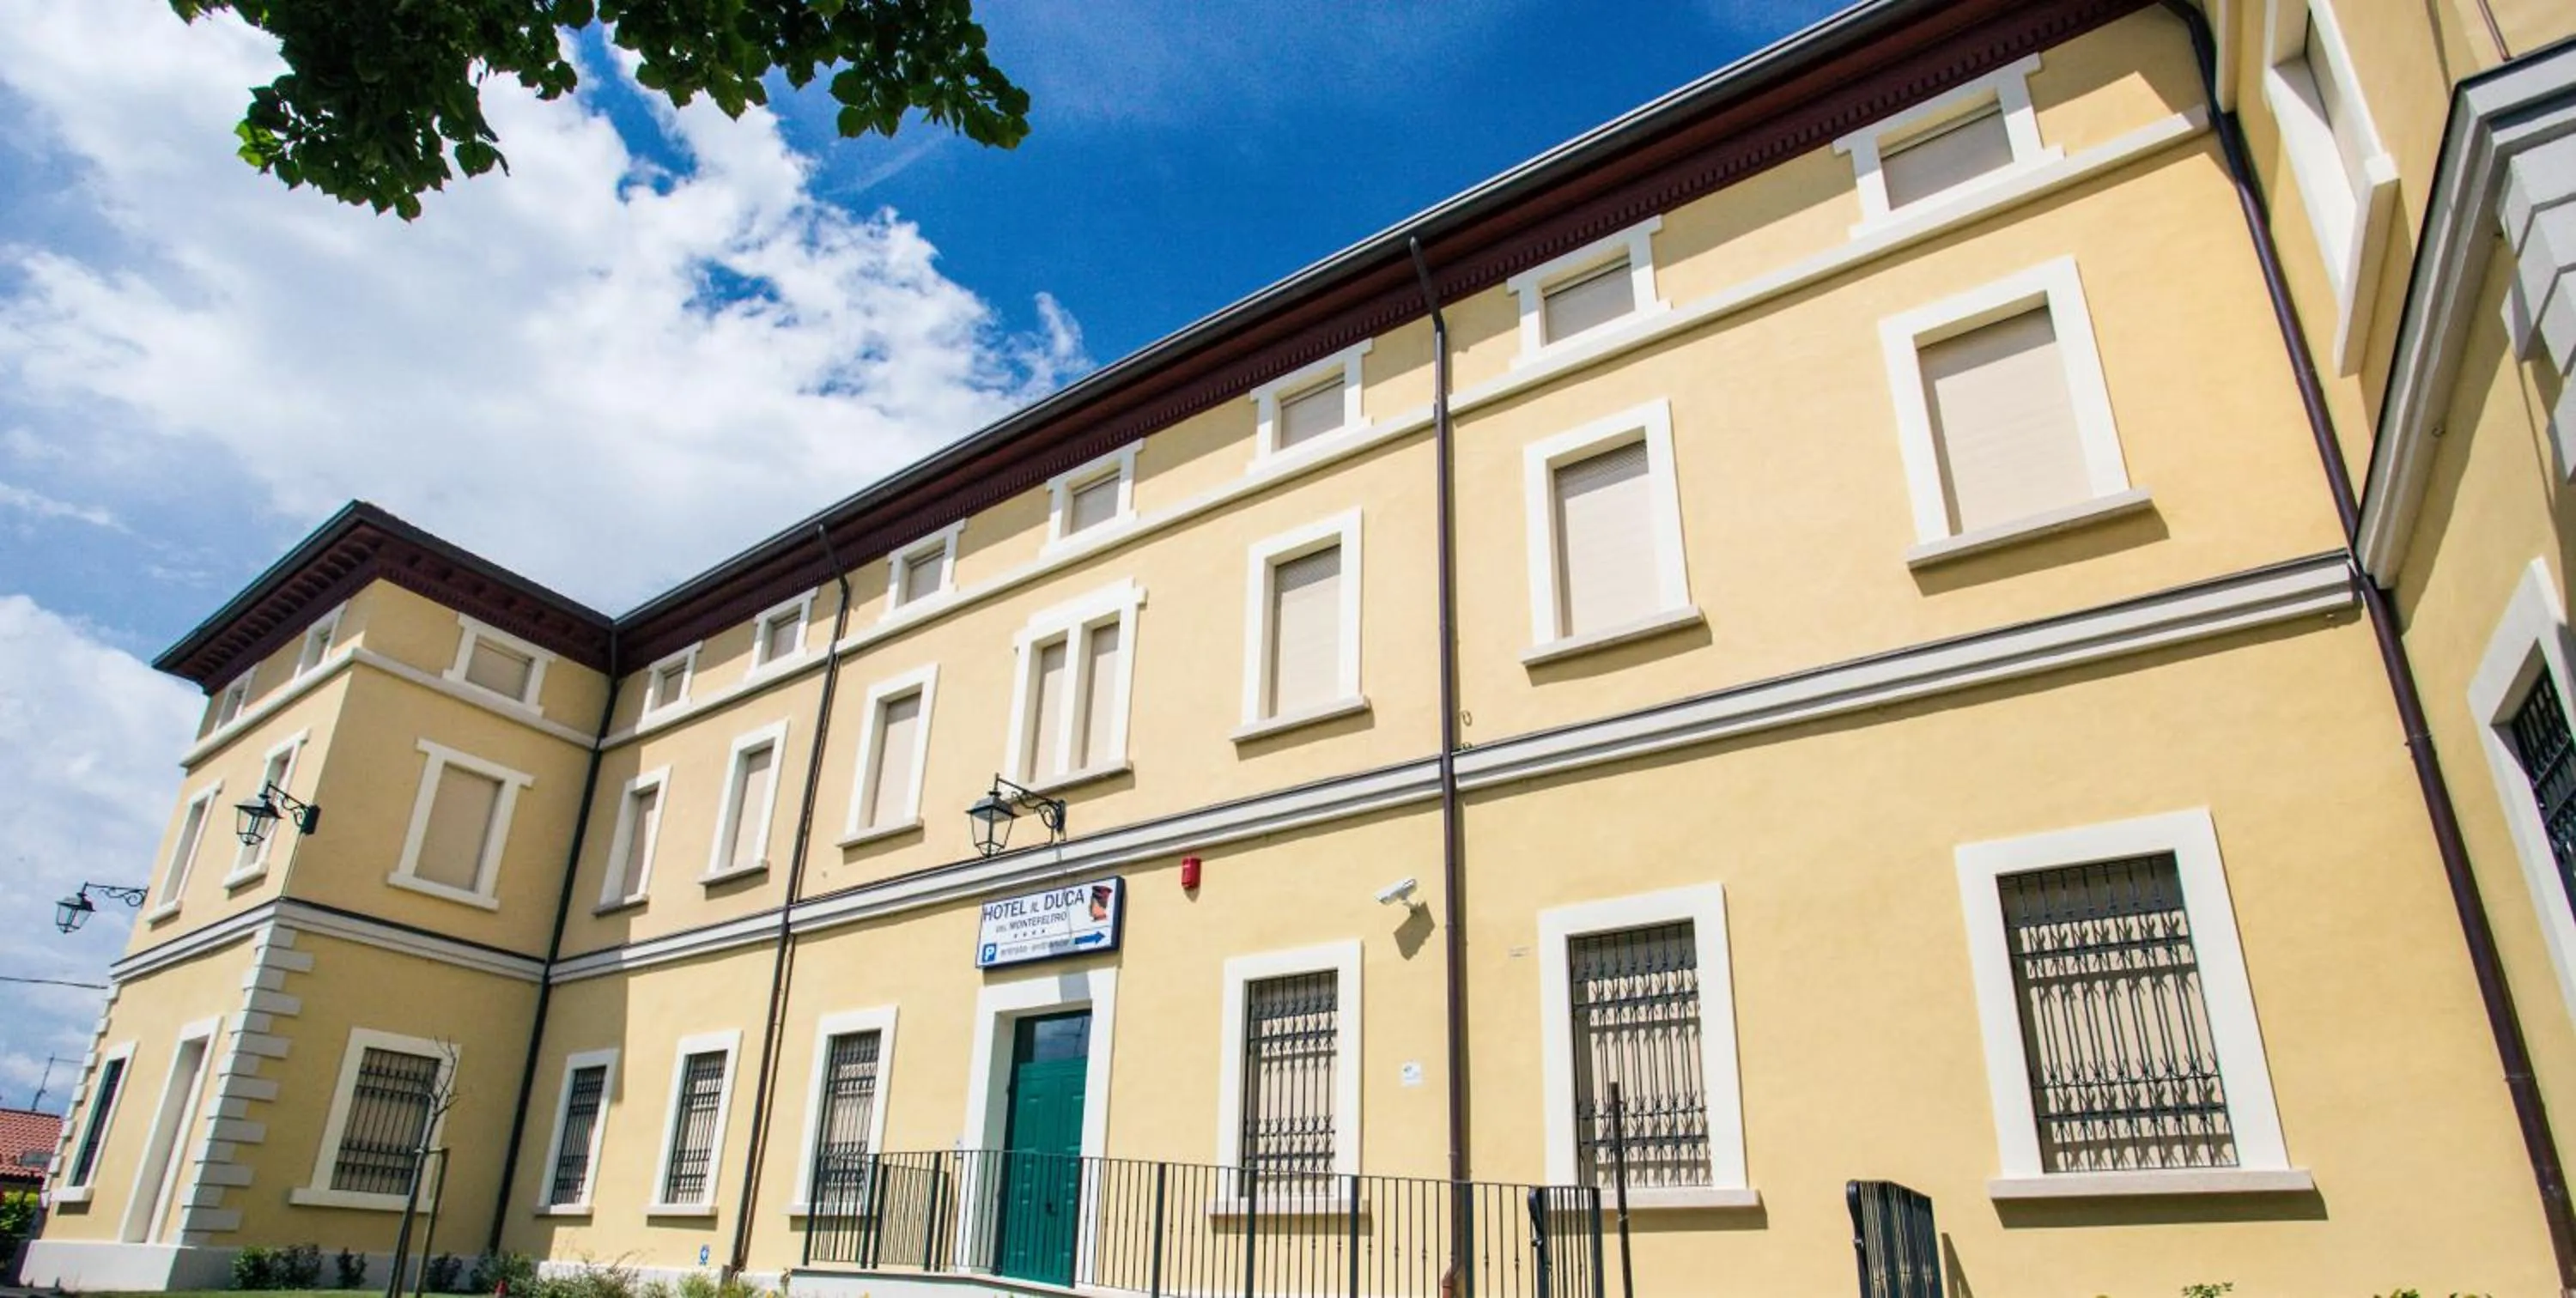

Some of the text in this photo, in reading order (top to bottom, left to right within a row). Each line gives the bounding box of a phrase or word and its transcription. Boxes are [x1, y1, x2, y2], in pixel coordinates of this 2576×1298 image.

[983, 889, 1084, 921] HOTEL IL DUCA
[1010, 911, 1067, 930] MONTEFELTRO
[985, 946, 995, 961] P
